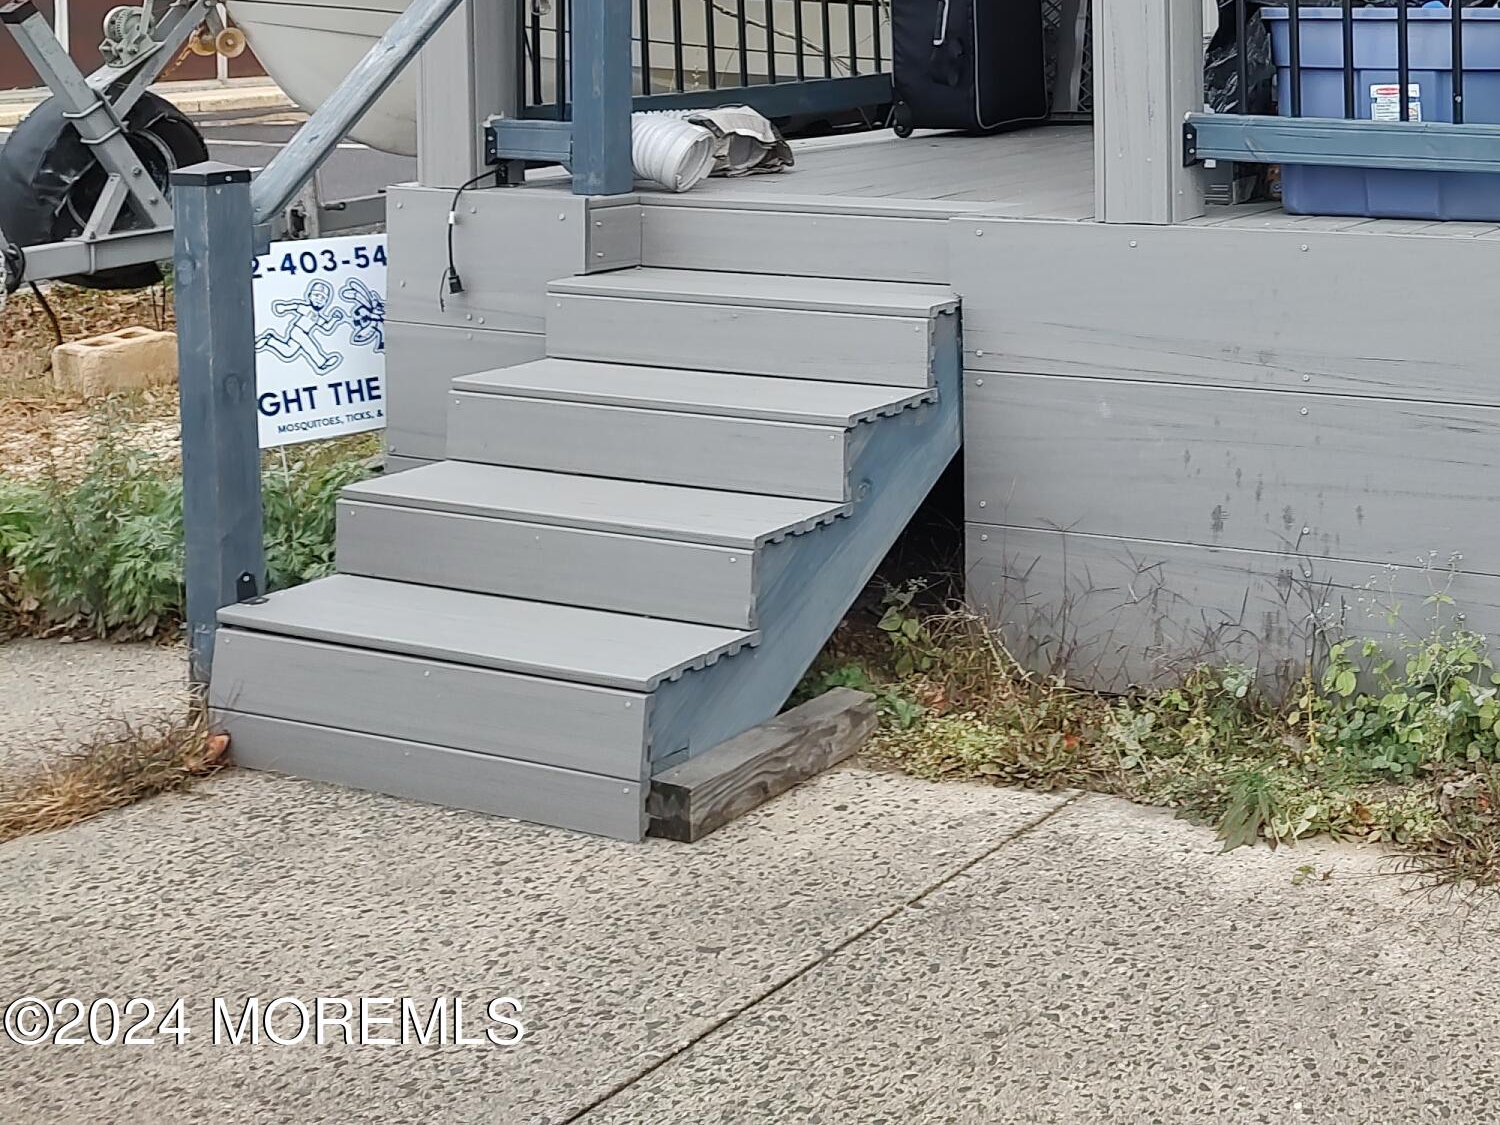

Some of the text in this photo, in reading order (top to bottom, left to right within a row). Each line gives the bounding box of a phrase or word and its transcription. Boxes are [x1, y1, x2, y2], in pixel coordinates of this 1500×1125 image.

[327, 377, 382, 406] THE
[278, 416, 343, 433] MOSQUITOES,
[345, 411, 374, 422] TICKS,
